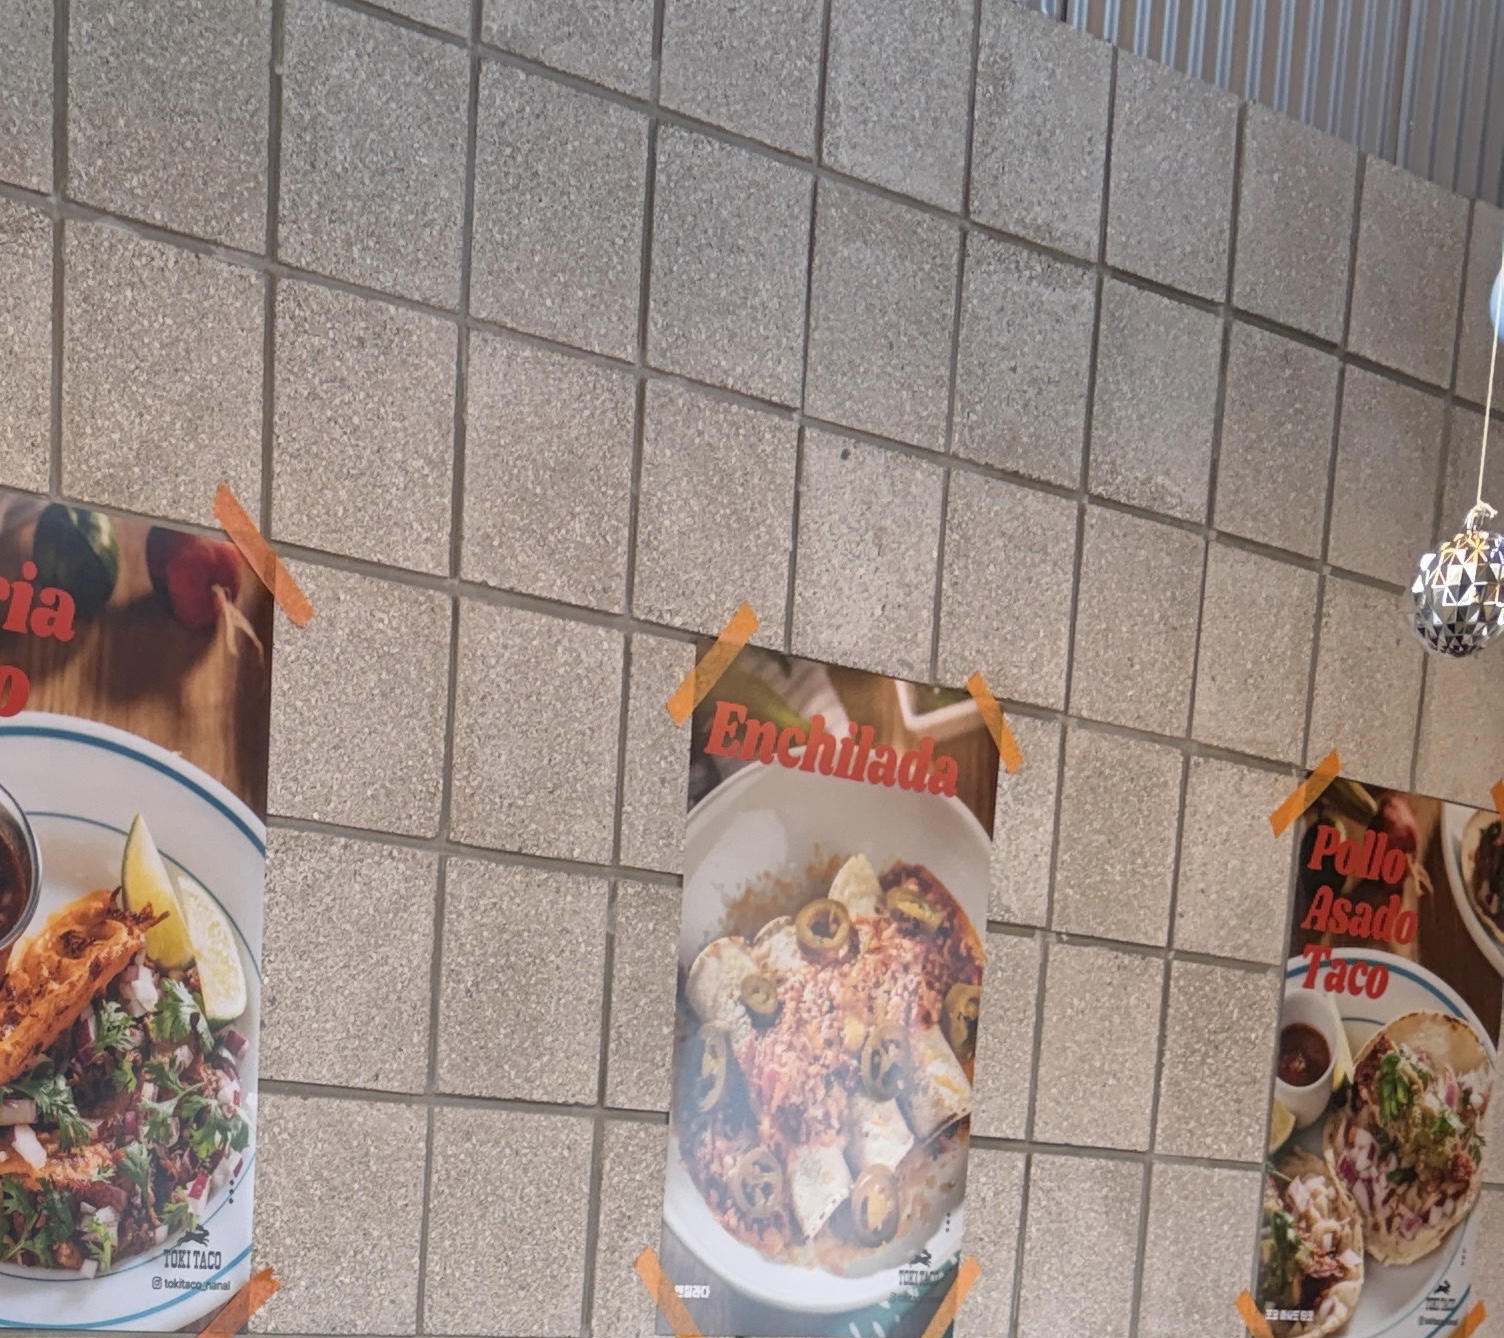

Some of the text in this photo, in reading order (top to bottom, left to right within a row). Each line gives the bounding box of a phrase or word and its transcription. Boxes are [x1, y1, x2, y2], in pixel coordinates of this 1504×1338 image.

[704, 701, 959, 797] Enchilada
[1307, 824, 1407, 885] Pollo
[1301, 885, 1418, 945] Asado
[1302, 944, 1389, 999] Taco
[163, 1249, 222, 1270] TOKI TACO
